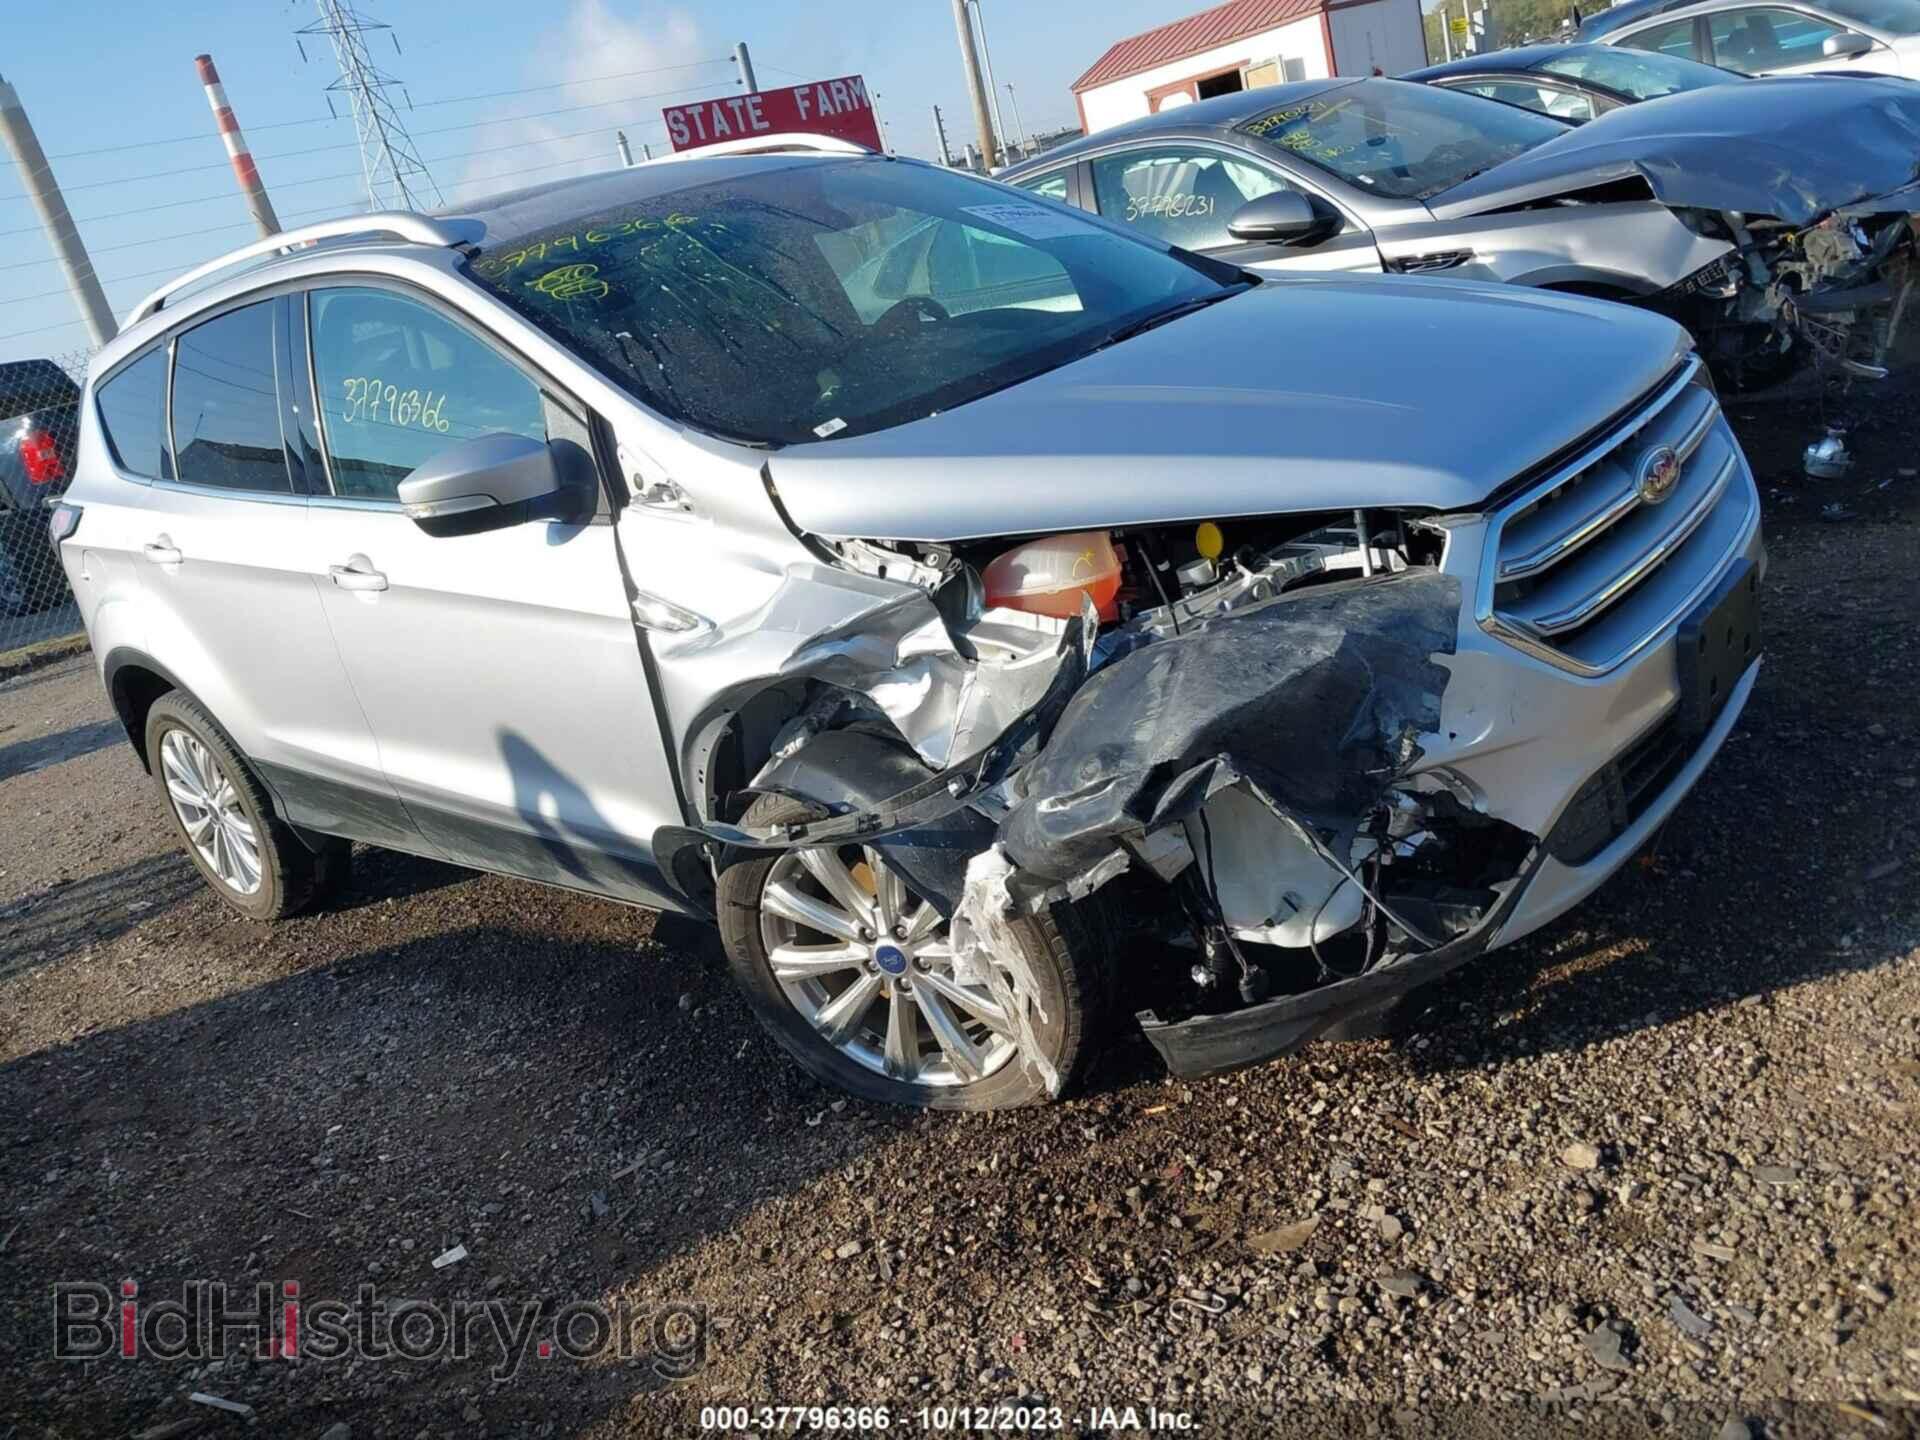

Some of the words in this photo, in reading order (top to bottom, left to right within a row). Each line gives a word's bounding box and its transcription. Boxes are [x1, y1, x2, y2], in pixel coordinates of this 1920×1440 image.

[666, 95, 770, 145] STATE
[793, 77, 872, 120] FARM
[343, 377, 449, 432] 37796366
